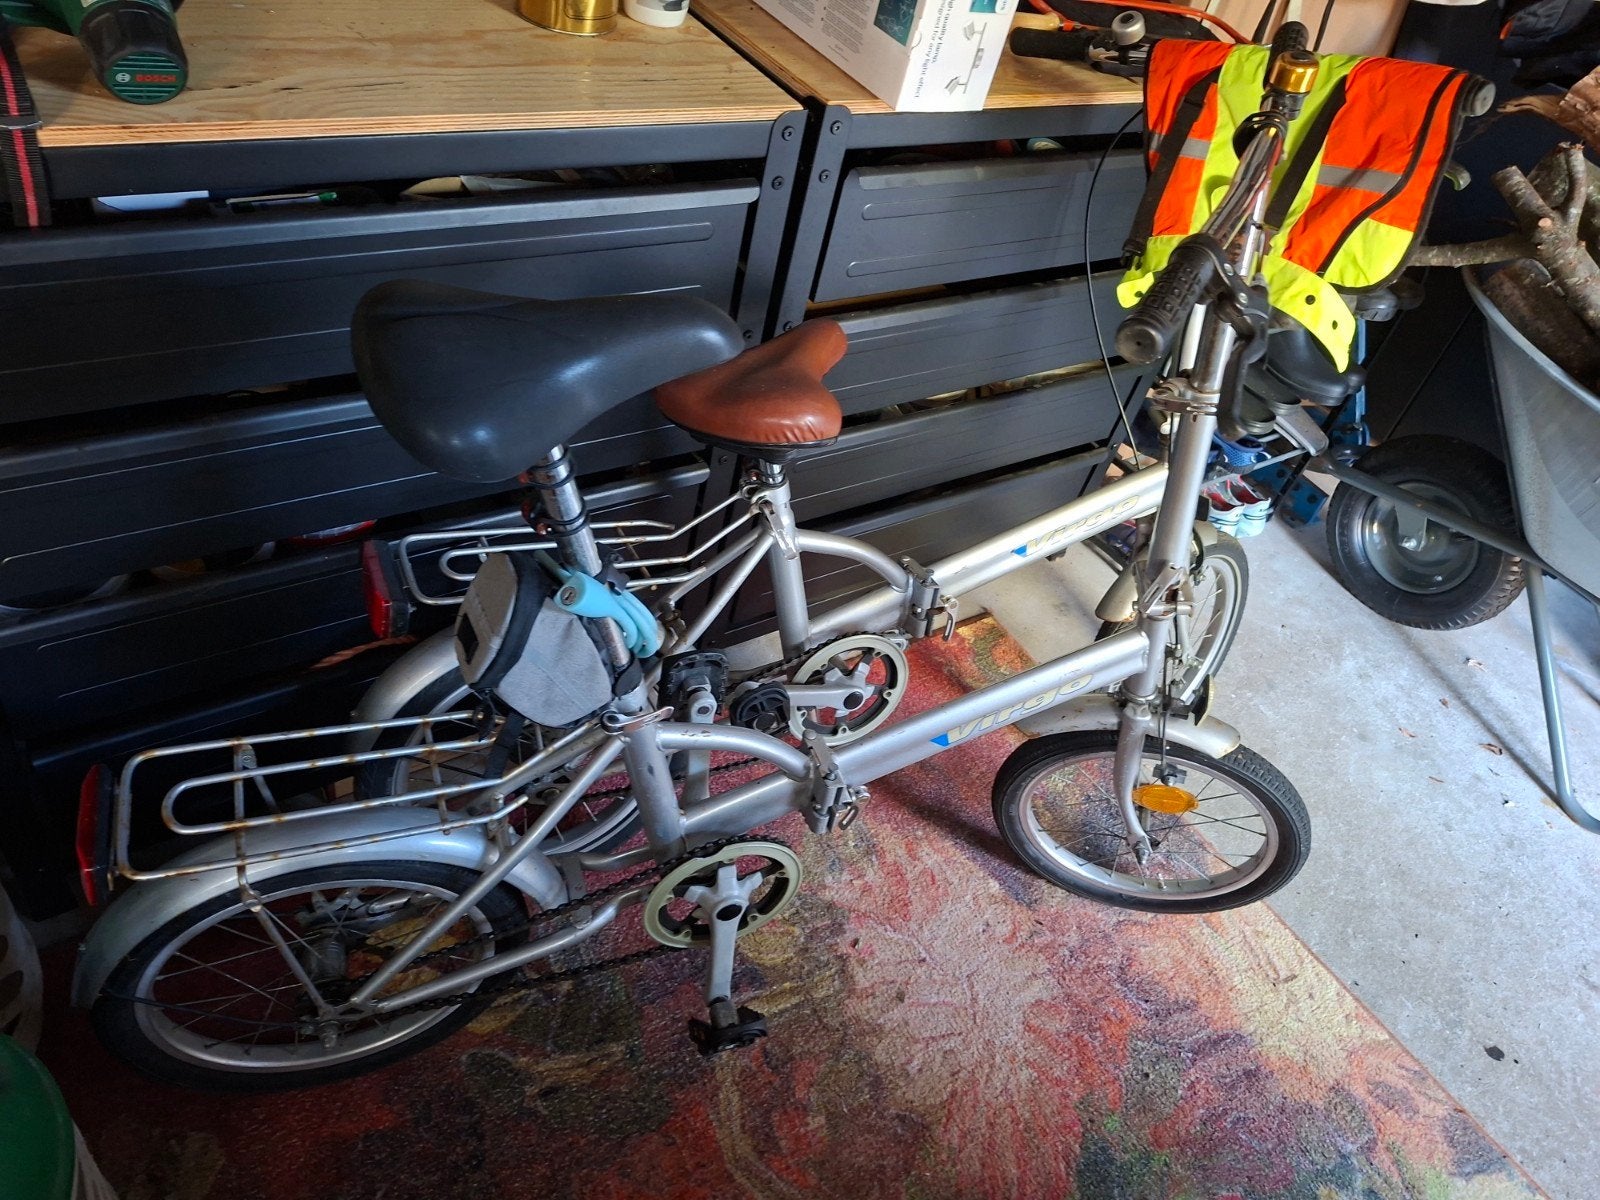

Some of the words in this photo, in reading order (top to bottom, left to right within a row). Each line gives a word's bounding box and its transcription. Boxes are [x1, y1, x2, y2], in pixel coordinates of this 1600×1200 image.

[938, 13, 949, 41] quality
[931, 30, 939, 41] for
[925, 42, 933, 57] any
[921, 59, 930, 75] light
[136, 74, 176, 83] BOSCH
[948, 674, 1094, 744] Virgo
